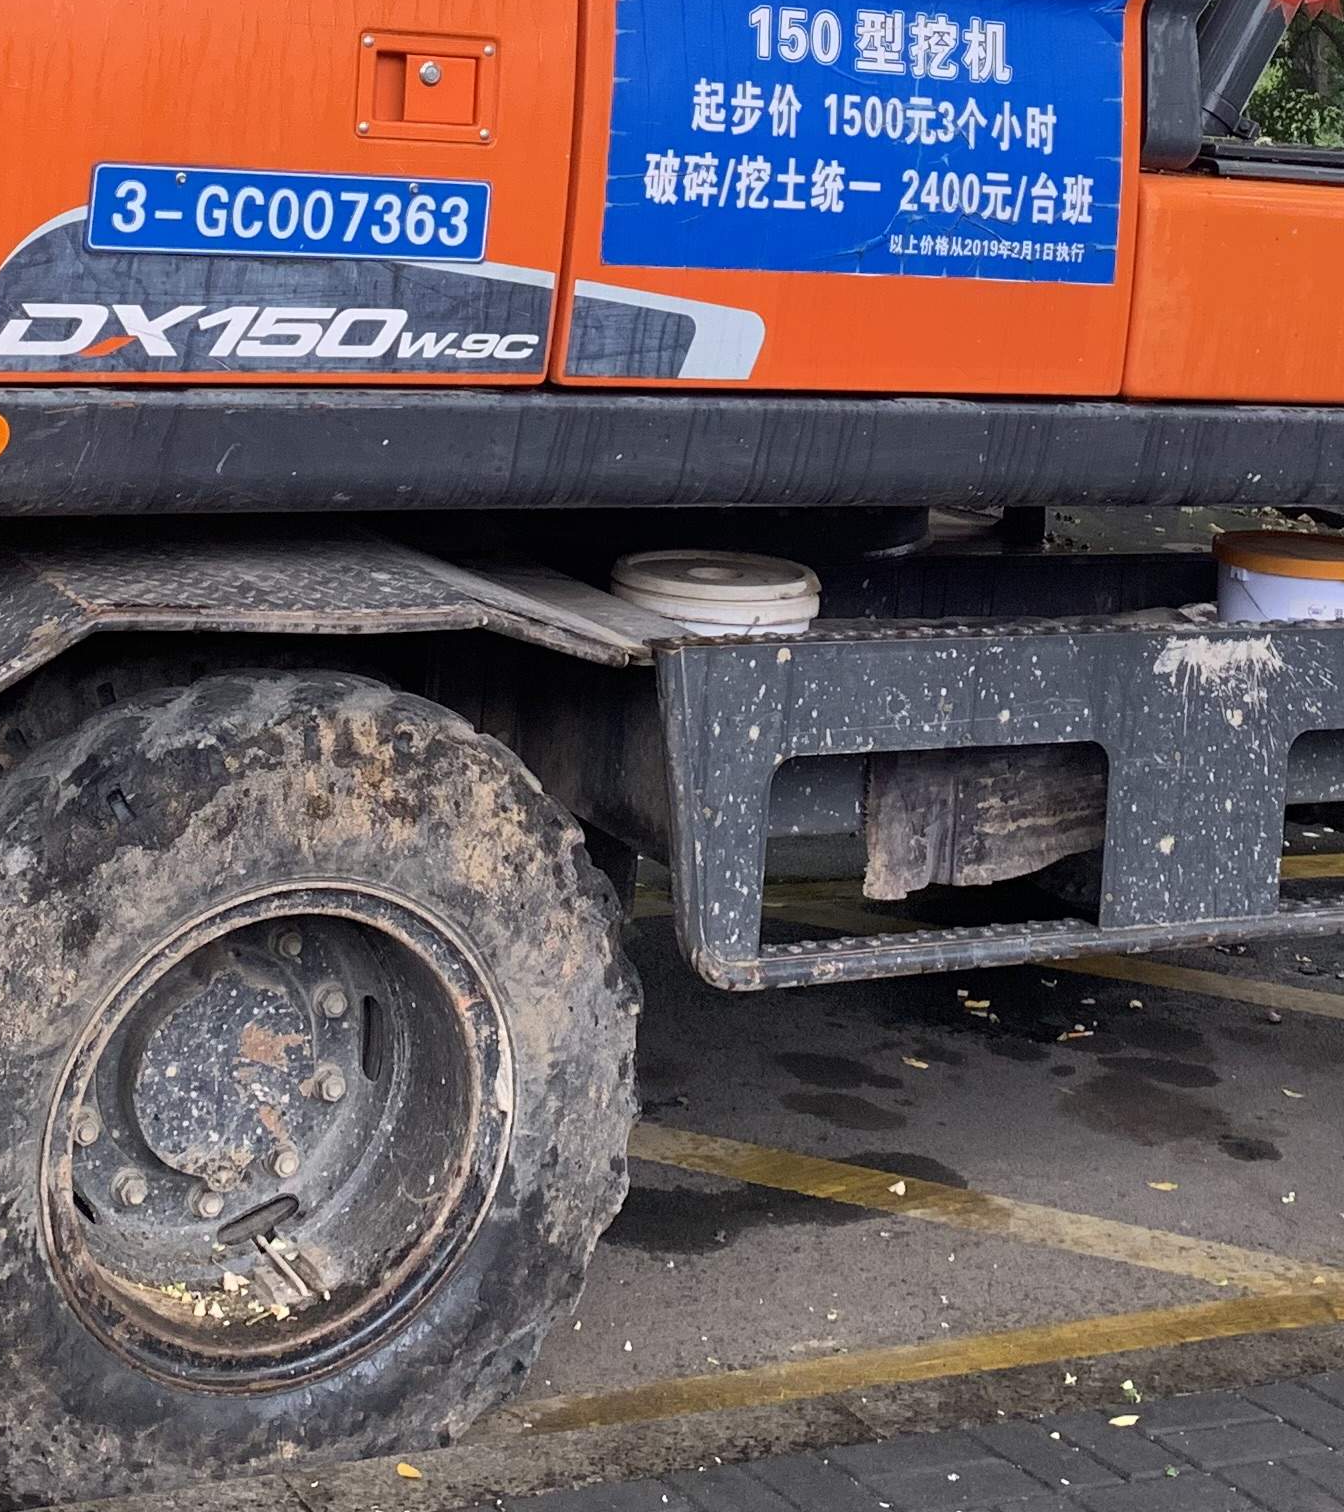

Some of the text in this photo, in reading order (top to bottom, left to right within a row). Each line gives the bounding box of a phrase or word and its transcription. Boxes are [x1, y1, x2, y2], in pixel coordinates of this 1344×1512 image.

[749, 5, 1013, 85] 150 型挖机
[691, 78, 1058, 155] 起步价 1500元3个小时
[112, 178, 470, 246] 3-GC007363
[644, 149, 1094, 225] 破碎/挖土统一 2400元/台班
[889, 234, 1086, 264] 以上价格从2019年2月1日执行
